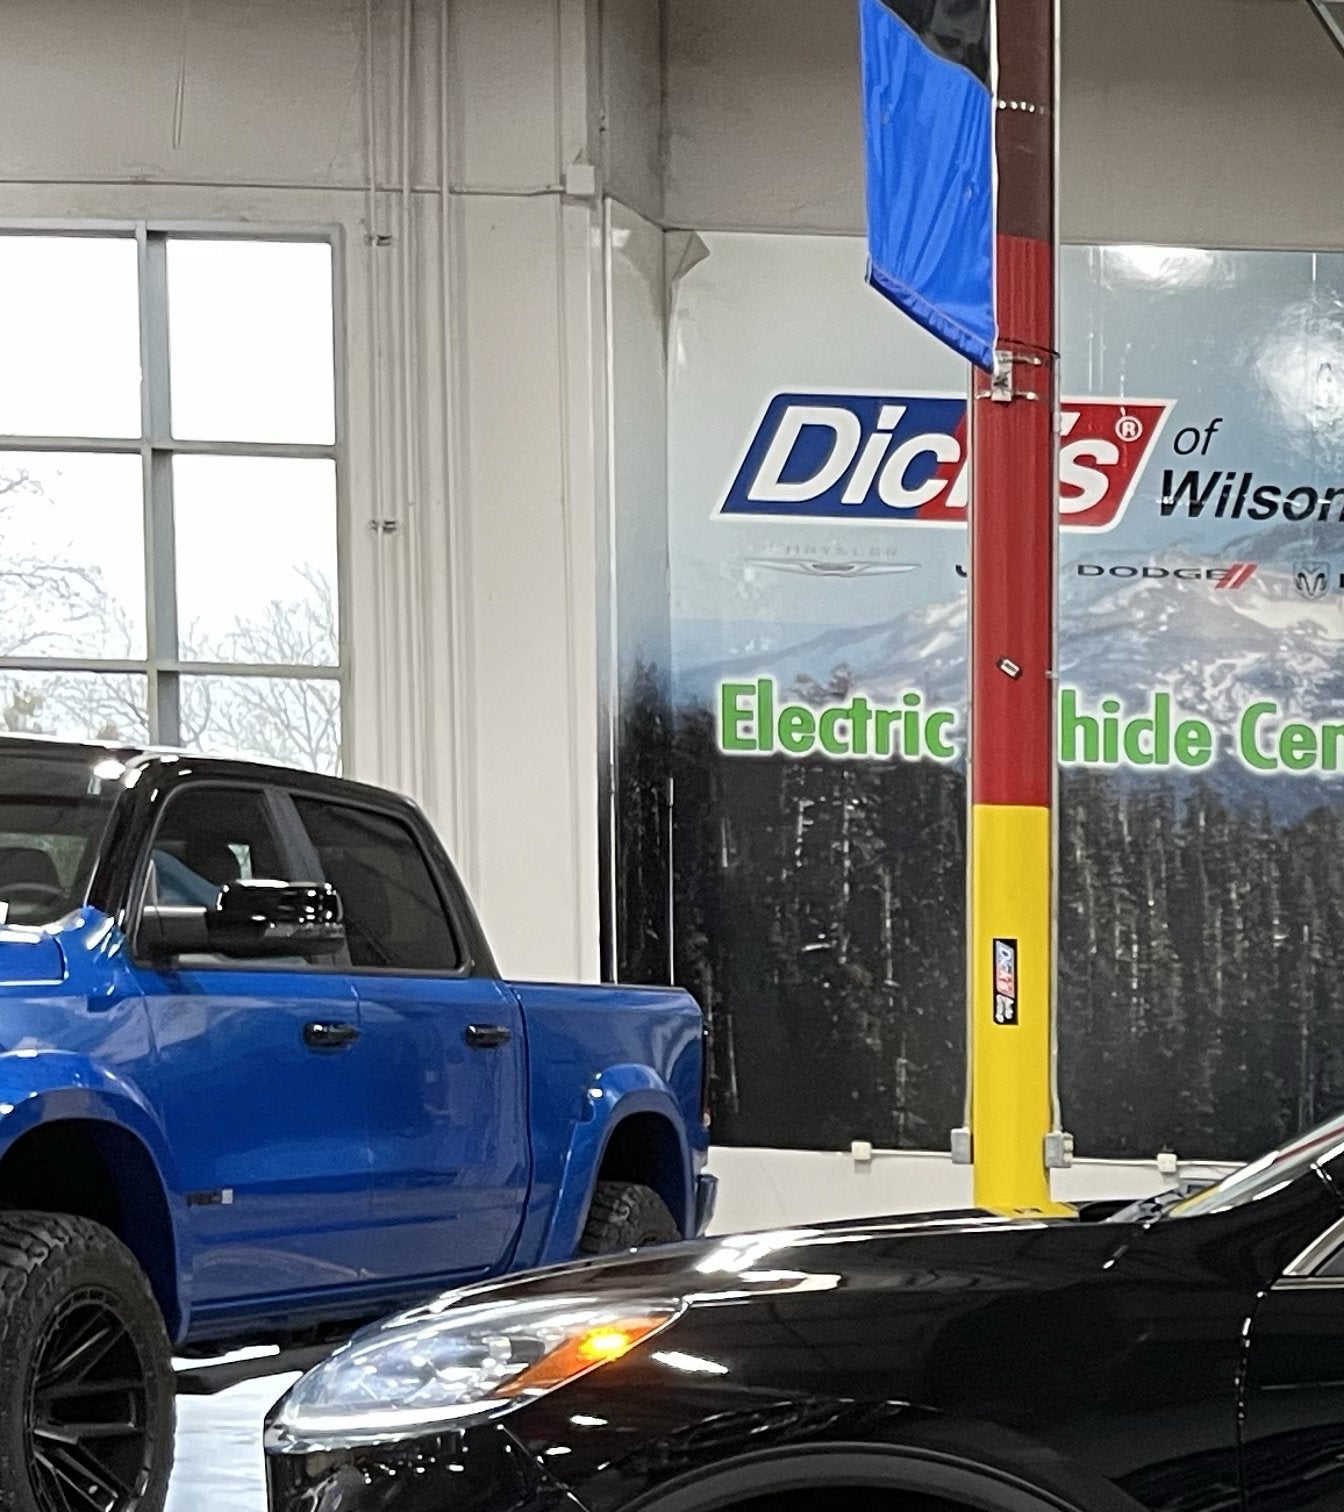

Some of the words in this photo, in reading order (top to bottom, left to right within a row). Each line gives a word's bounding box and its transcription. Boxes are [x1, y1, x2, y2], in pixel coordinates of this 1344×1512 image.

[1172, 418, 1223, 456] of
[1077, 564, 1231, 580] DODGE
[721, 679, 955, 756] Electric
